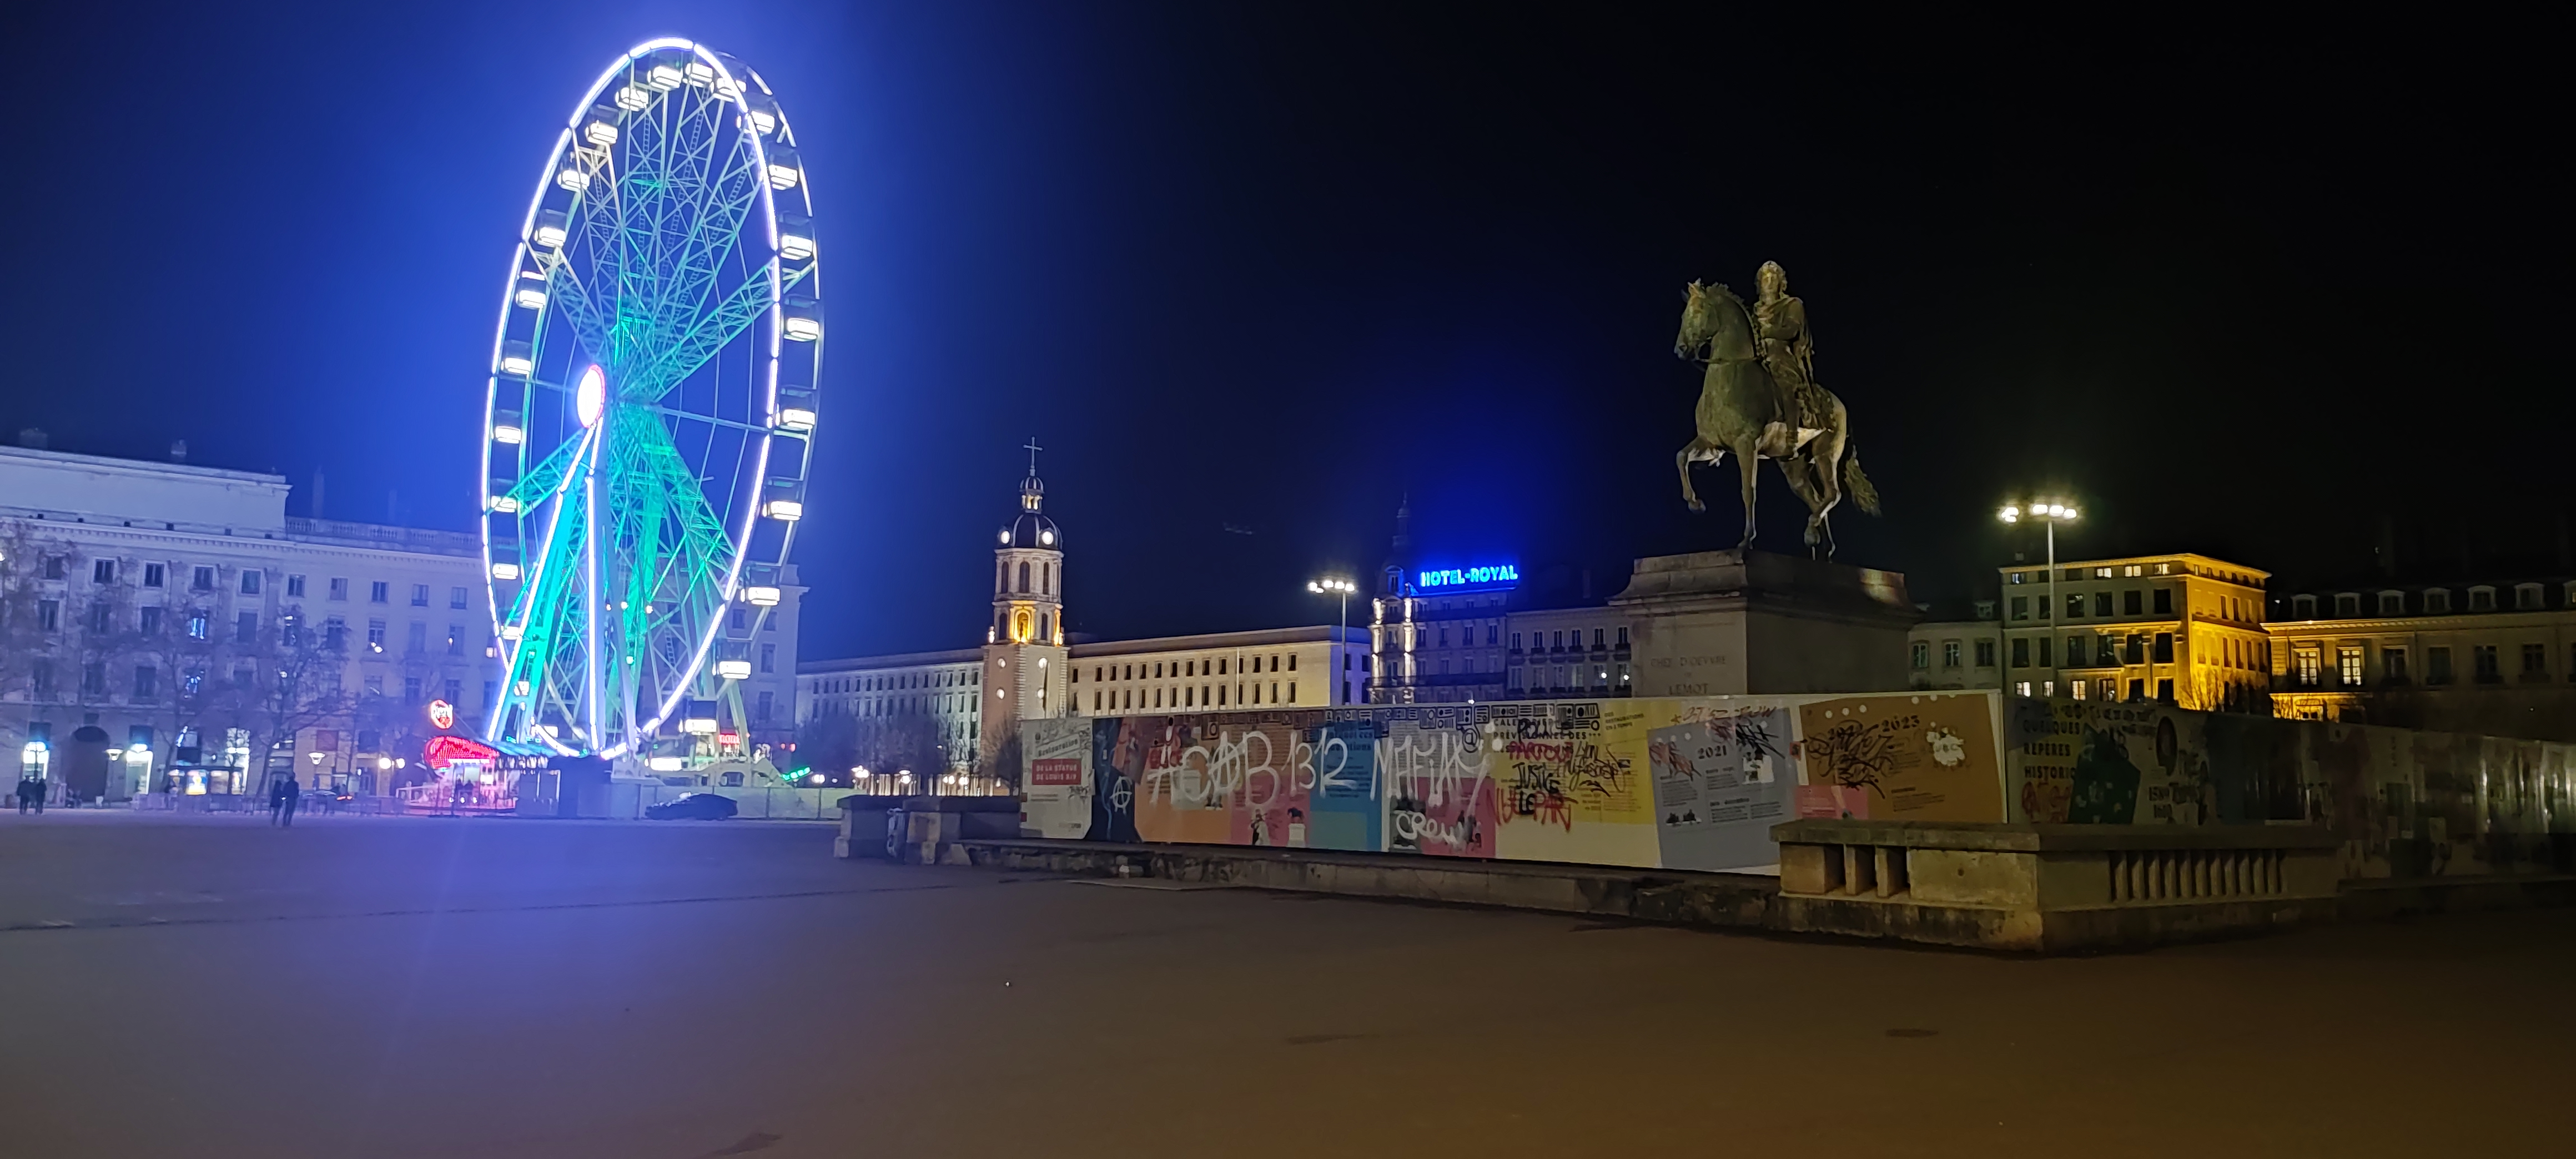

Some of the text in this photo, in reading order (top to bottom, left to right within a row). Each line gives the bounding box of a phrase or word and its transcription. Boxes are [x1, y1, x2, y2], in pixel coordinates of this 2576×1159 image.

[1420, 565, 1518, 587] HOTEL-ROYAL
[1668, 683, 1709, 696] LEMOT
[1697, 744, 1728, 760] 2021
[1281, 727, 1359, 800] 1312
